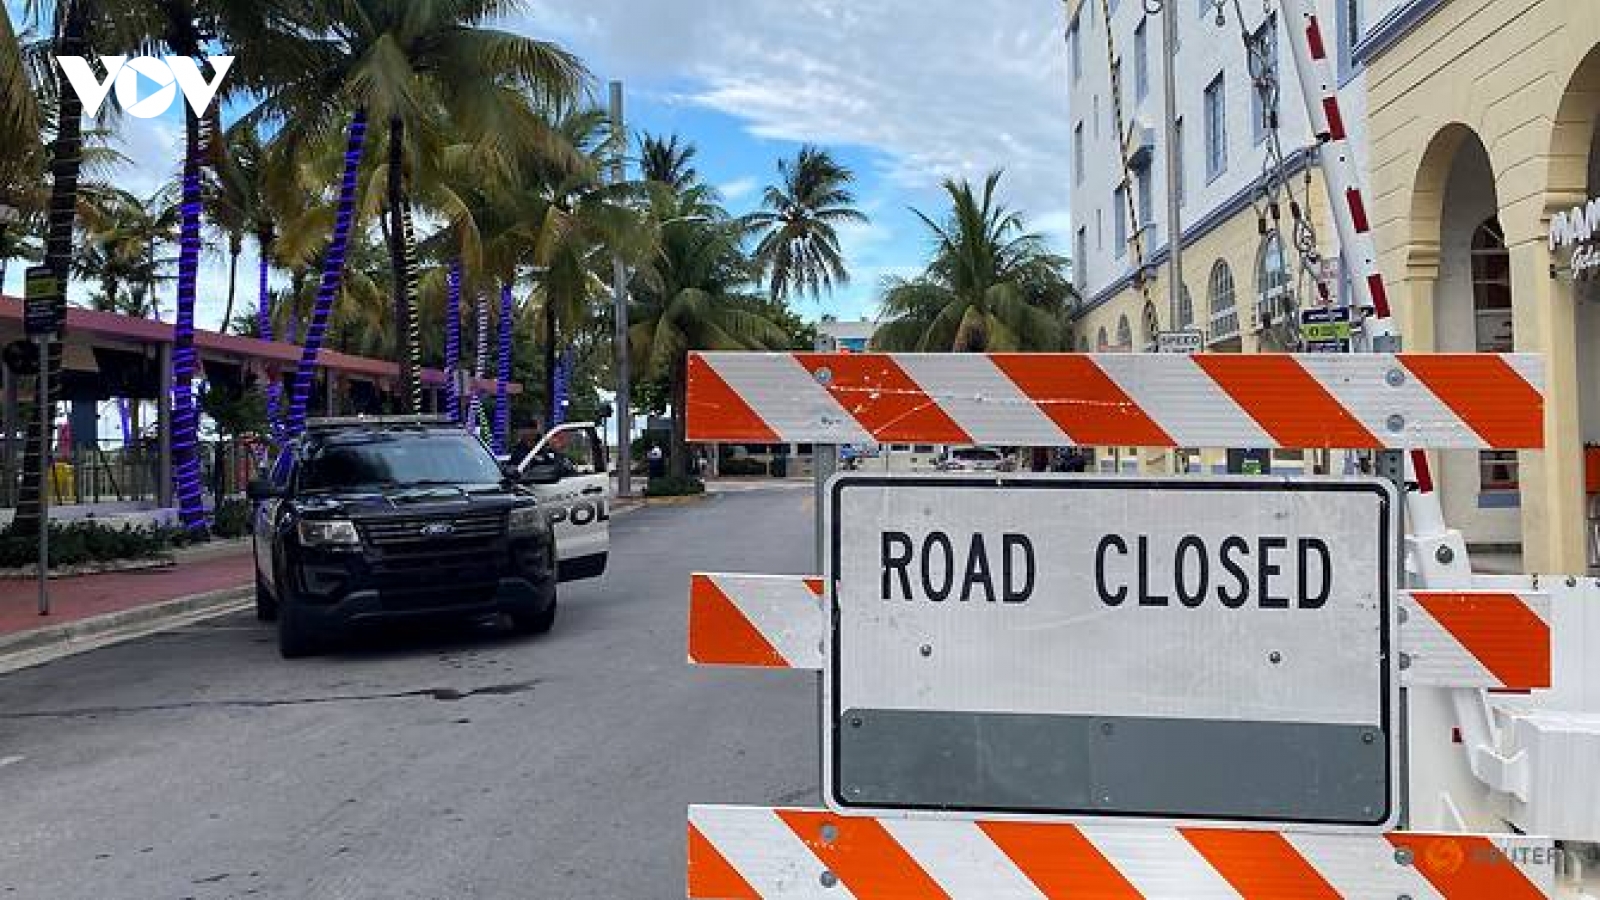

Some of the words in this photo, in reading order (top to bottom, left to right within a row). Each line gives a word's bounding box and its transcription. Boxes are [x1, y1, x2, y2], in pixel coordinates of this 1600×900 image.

[1161, 335, 1199, 346] SPEED
[881, 532, 1035, 603] ROAD
[1096, 534, 1331, 609] CLOSED
